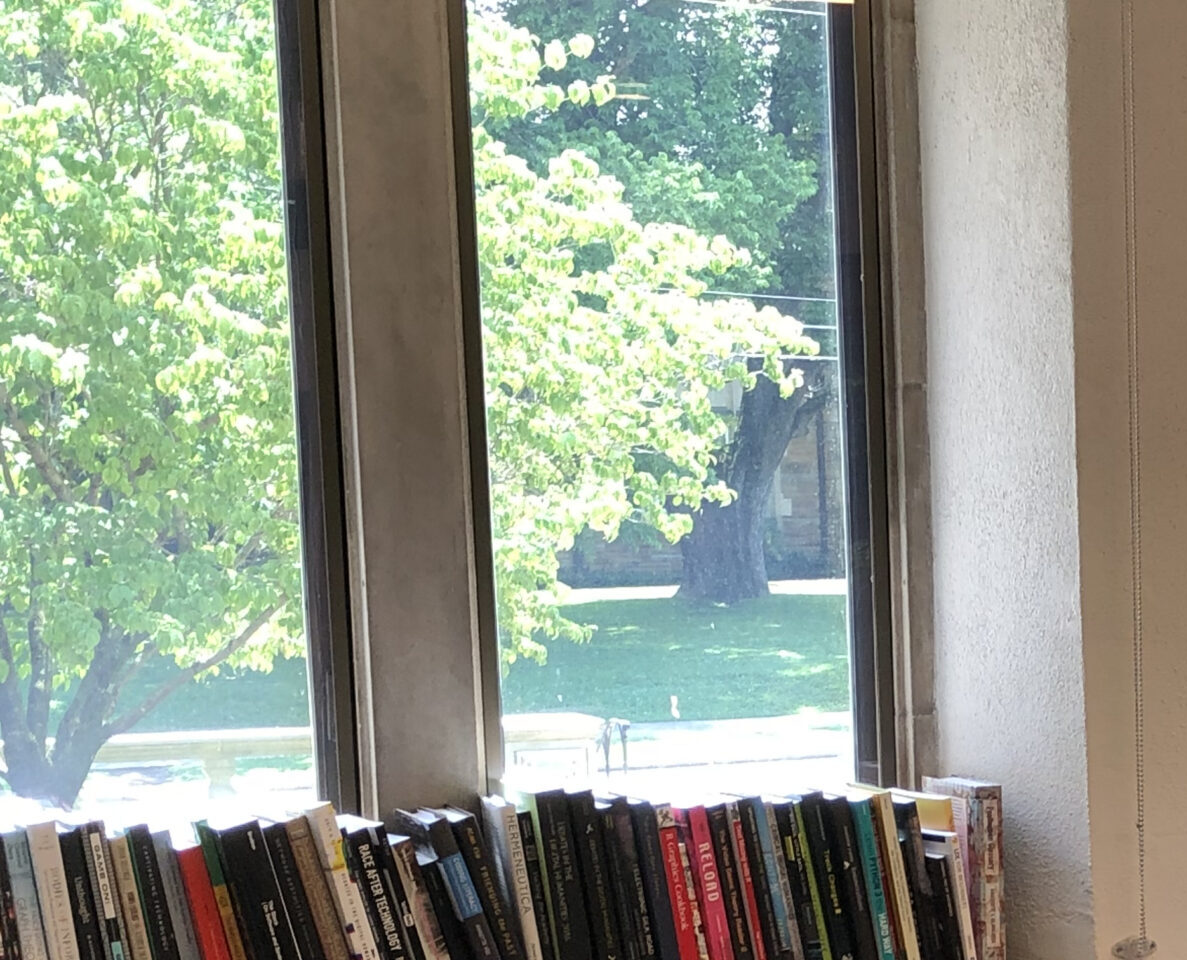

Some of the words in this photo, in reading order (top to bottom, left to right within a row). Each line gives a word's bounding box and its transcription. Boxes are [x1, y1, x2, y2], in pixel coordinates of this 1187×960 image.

[93, 844, 105, 879] GAME
[358, 843, 373, 868] RACE
[505, 814, 532, 914] HERMENEUTICA
[698, 842, 719, 902] RELOAD
[822, 849, 833, 872] Track
[366, 868, 383, 895] AFTER
[665, 842, 680, 882] Graphics
[673, 884, 689, 930] Cookbook
[826, 874, 841, 907] Changes
[72, 876, 91, 923] Unthought
[480, 865, 501, 915] FRIENDING
[501, 932, 516, 956] PAST
[374, 895, 401, 952] TECHNOLOGY
[877, 912, 889, 936] HARD
[881, 936, 893, 954] WAY
